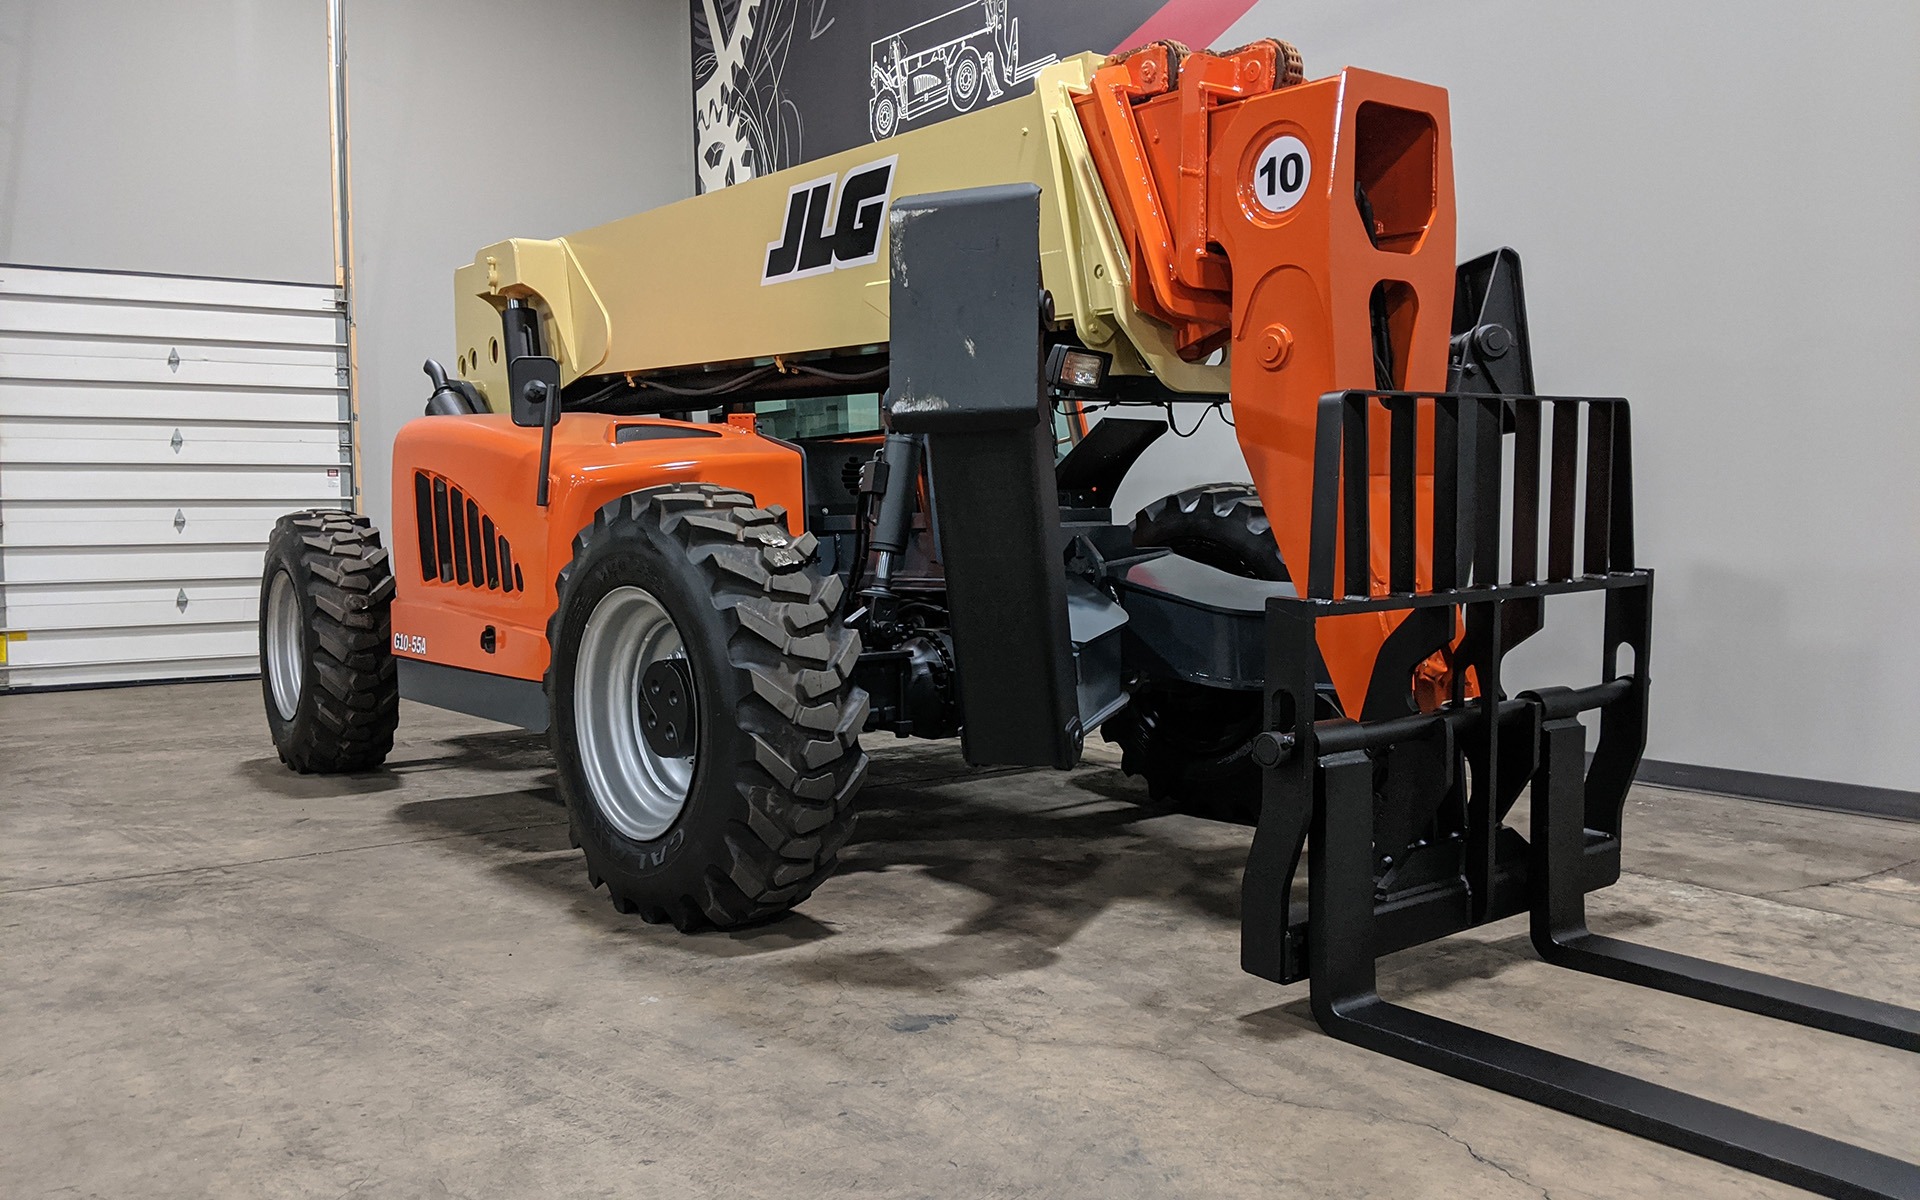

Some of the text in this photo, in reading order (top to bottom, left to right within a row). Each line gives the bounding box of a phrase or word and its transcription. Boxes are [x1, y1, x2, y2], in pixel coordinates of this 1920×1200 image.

[1259, 152, 1304, 196] 10
[765, 164, 892, 278] JLG
[394, 632, 427, 655] G10-55A
